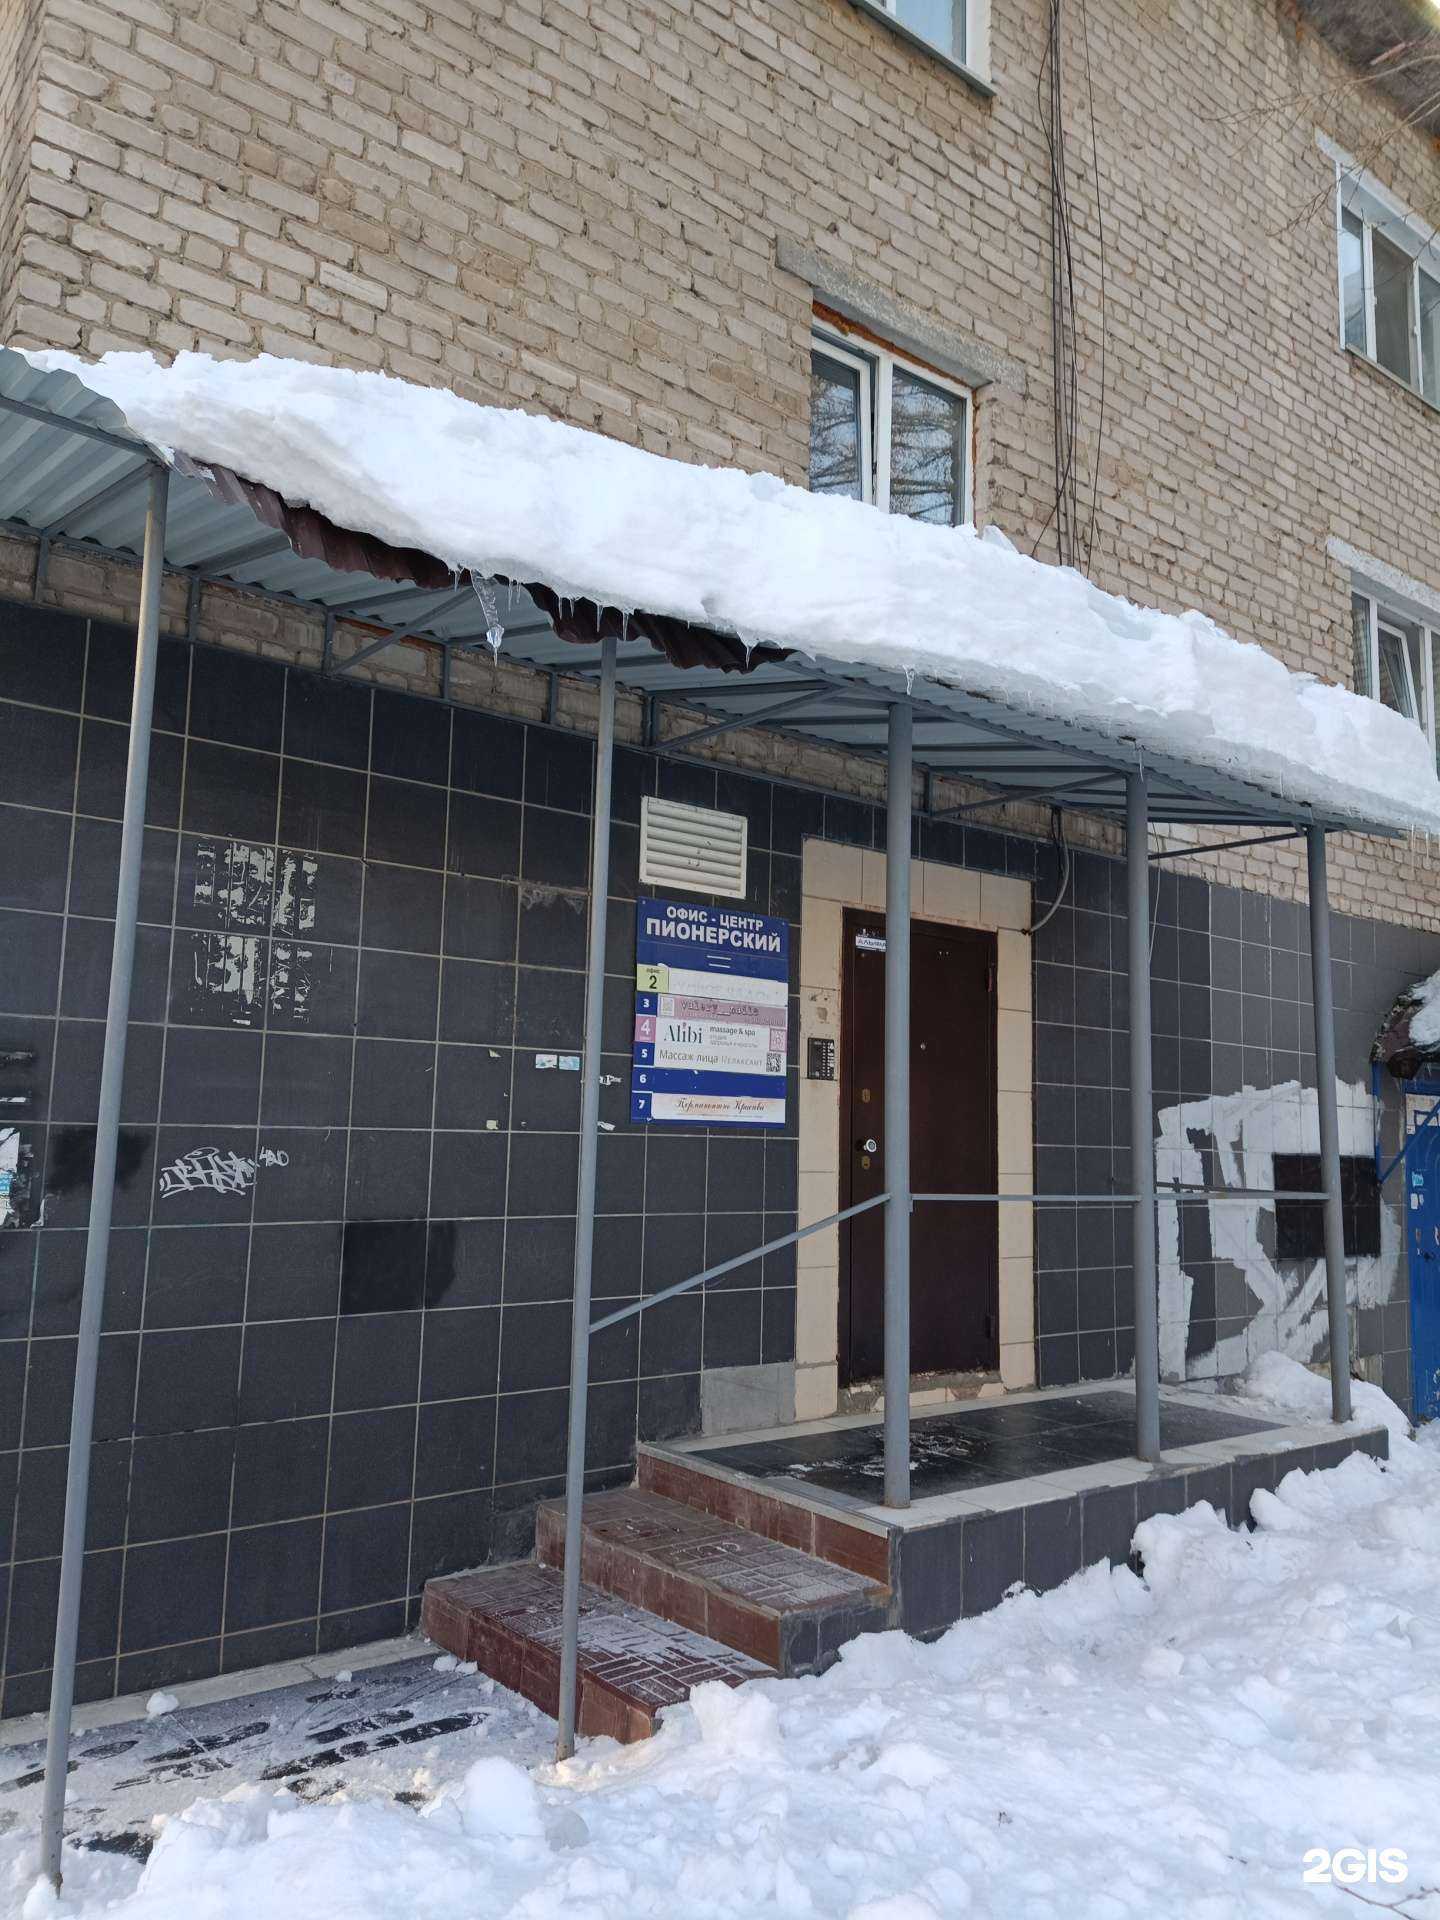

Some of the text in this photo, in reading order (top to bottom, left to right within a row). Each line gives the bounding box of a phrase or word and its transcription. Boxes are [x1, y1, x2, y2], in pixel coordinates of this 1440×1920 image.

[666, 906, 708, 923] ОФИС
[719, 914, 764, 932] ЦЕНТР
[646, 917, 782, 953] ПИОНЕРСКИЙ
[648, 975, 658, 990] 2
[642, 998, 650, 1008] 3
[640, 1019, 651, 1035] 4
[664, 1022, 703, 1044] Alibi
[709, 1025, 756, 1037] massage & spa
[641, 1048, 649, 1059] 5
[659, 1049, 694, 1061] Массаж
[696, 1054, 719, 1065] лица
[639, 1073, 647, 1084] 6
[638, 1099, 646, 1110] 7
